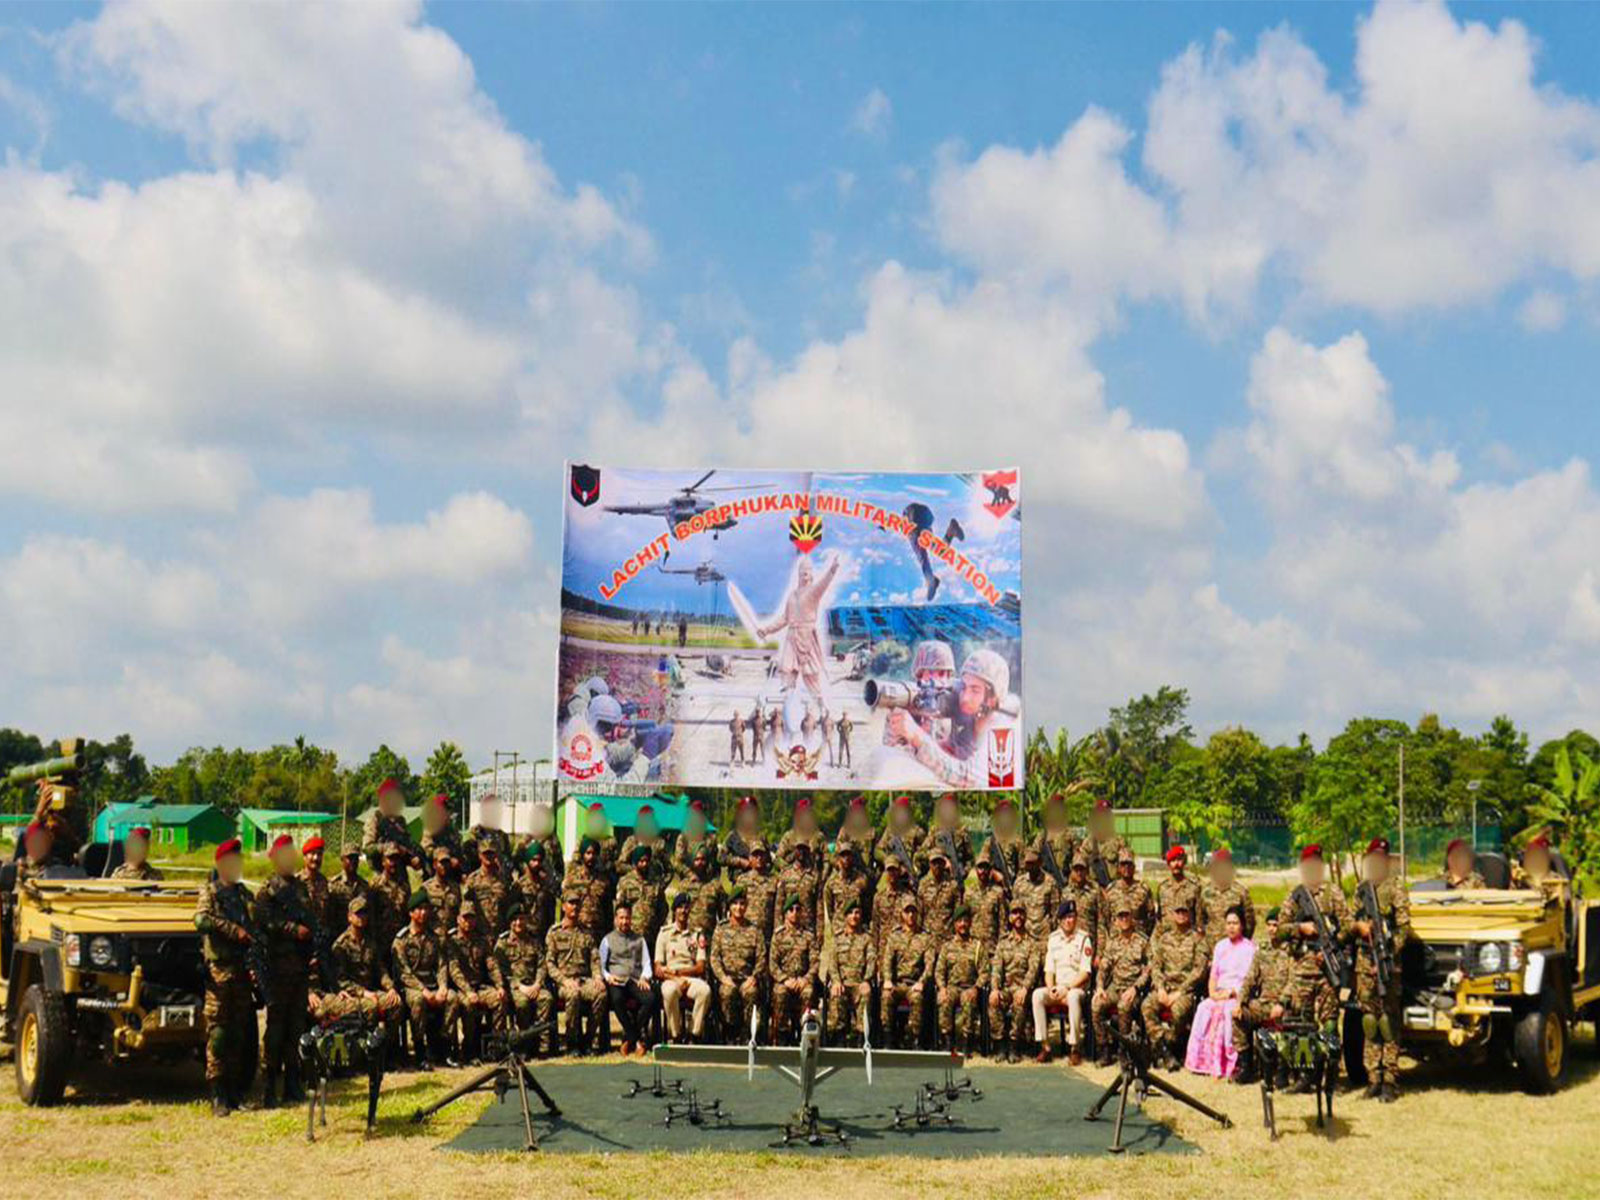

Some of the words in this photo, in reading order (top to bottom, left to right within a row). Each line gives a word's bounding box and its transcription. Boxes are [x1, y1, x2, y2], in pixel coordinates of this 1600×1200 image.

[600, 532, 669, 599] LACHIT
[676, 495, 809, 540] BORPHUKAN
[817, 496, 915, 536] MILITARY
[919, 530, 1000, 606] STATION
